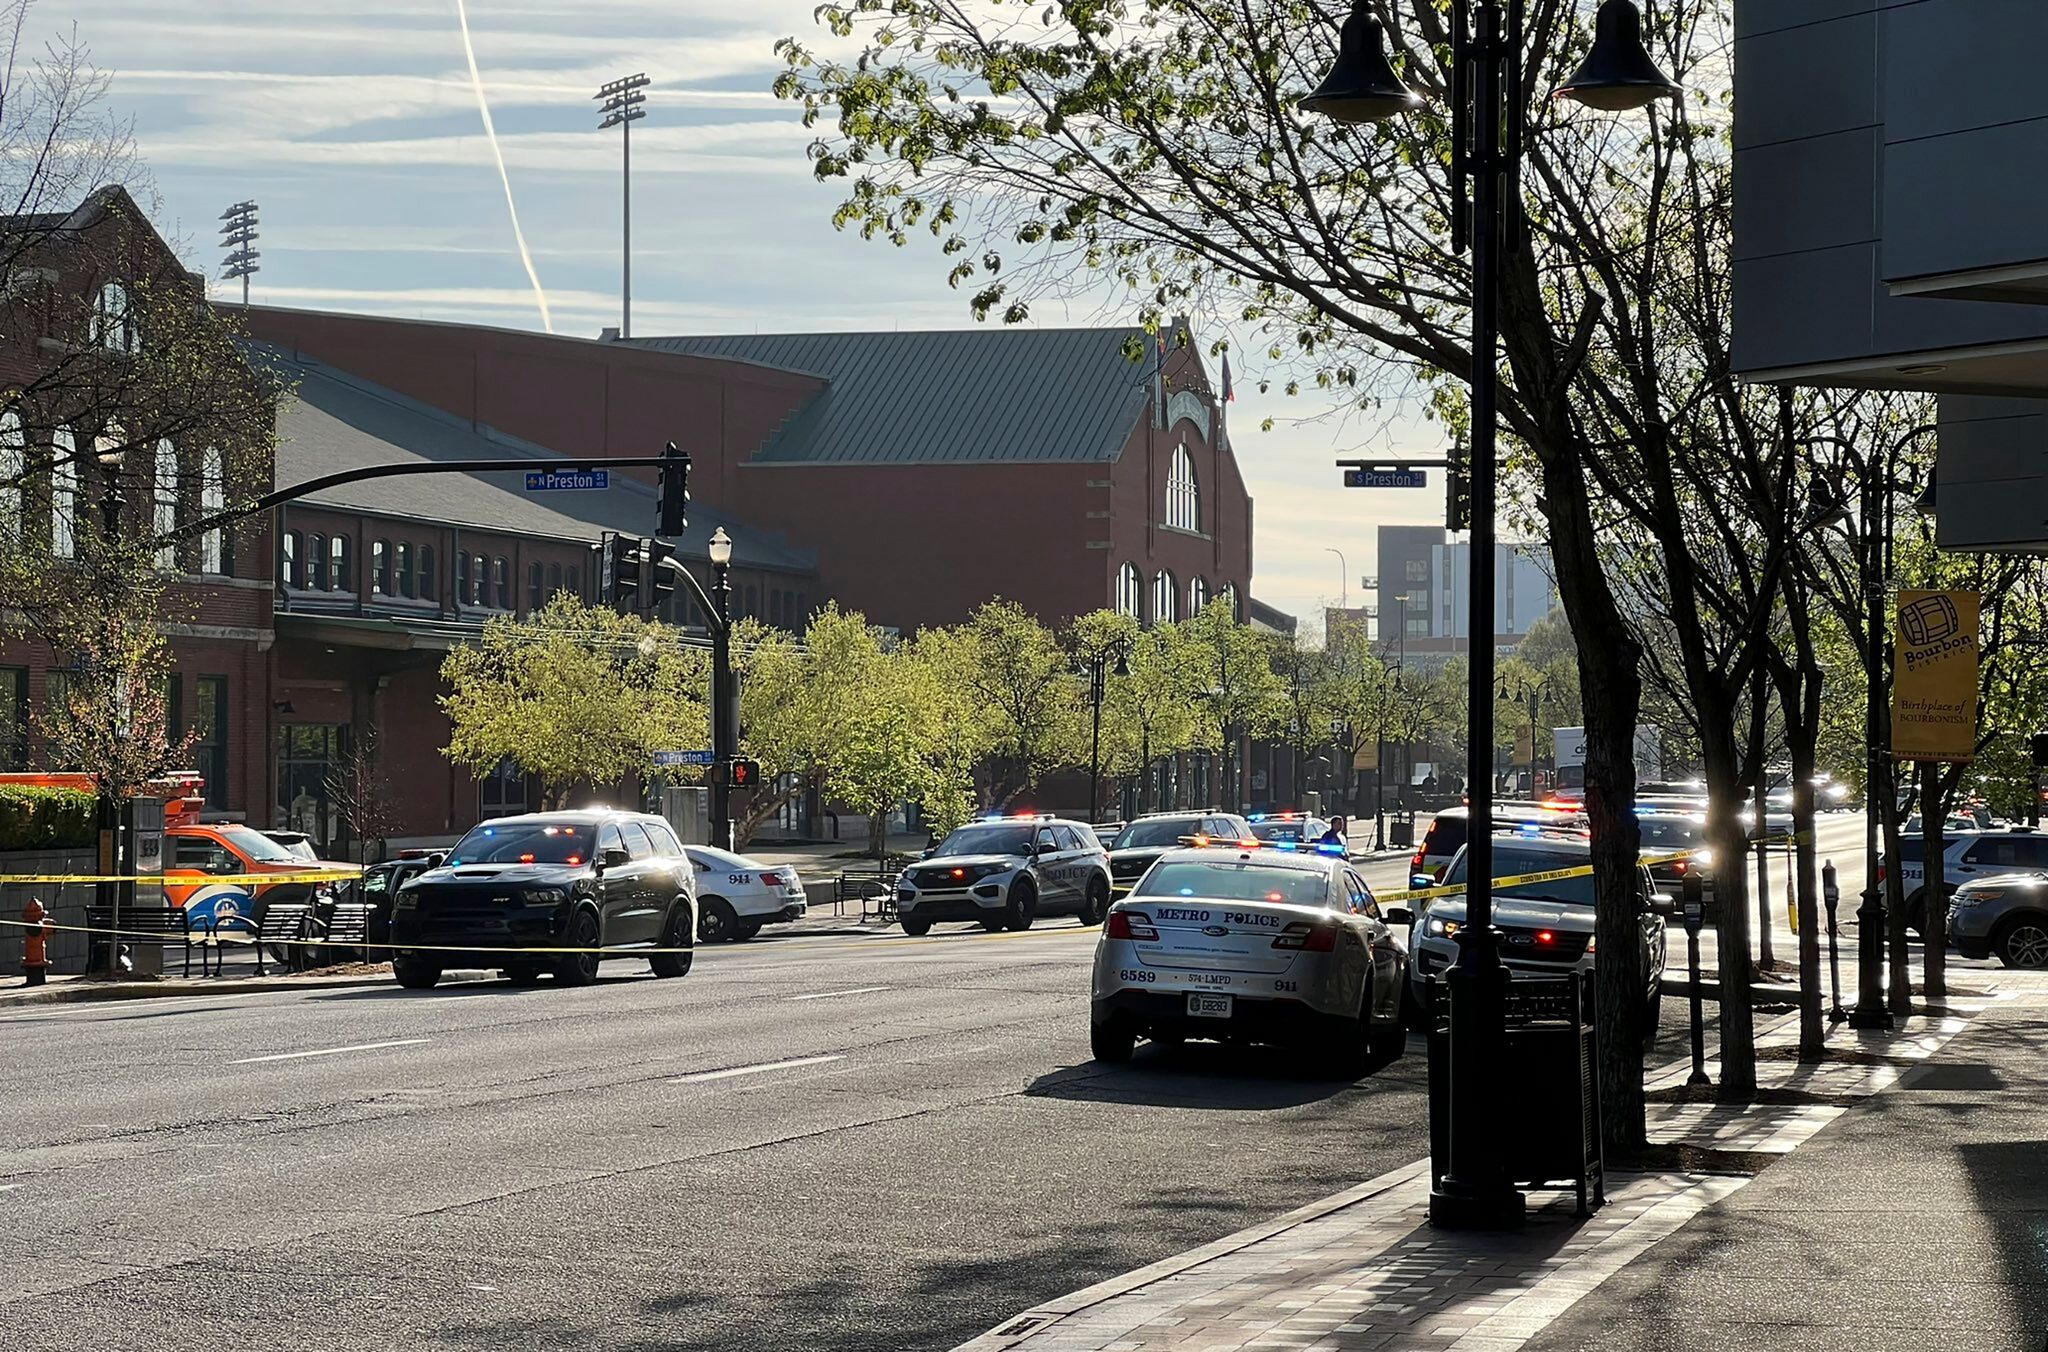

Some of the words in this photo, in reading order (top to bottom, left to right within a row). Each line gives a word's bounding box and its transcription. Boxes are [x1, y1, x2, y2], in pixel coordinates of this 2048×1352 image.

[538, 477, 545, 486] N
[546, 474, 593, 488] Preston
[1357, 474, 1363, 484] S
[1365, 472, 1411, 486] Preston
[1904, 635, 1972, 664] Bourbon
[1908, 644, 1974, 672] DISTRICT
[1901, 698, 1952, 714] Birthplace
[1954, 699, 1967, 714] of
[1900, 713, 1968, 724] BOURBONISM
[669, 752, 703, 763] Preston
[729, 874, 750, 885] 911
[1901, 869, 1923, 880] 911
[1156, 908, 1210, 922] METRO
[1224, 912, 1280, 928] POLICE
[1120, 969, 1156, 983] 6589
[1274, 980, 1297, 992] 911
